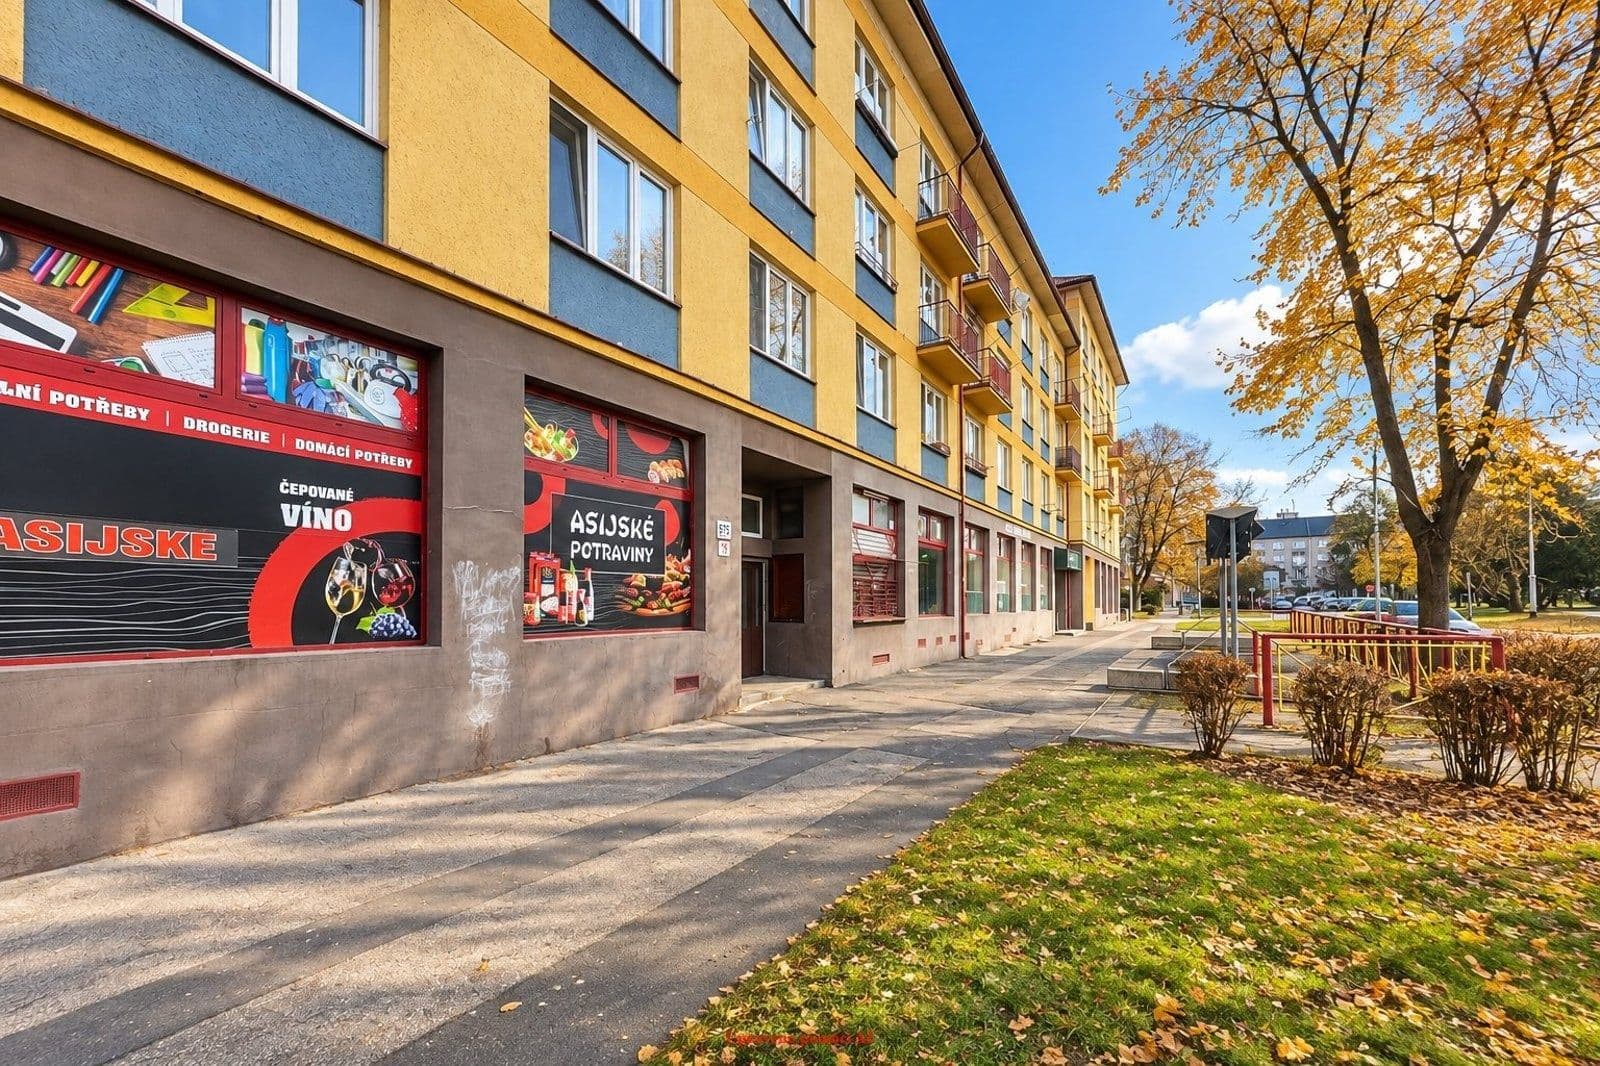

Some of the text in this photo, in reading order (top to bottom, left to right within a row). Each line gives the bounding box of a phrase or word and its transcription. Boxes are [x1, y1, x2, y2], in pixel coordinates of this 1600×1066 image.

[0, 379, 413, 469] LNÍ POTŘEBY DROGERIE DOMÁCÍ POTŘEBY
[279, 479, 354, 502] ČEPOVANÉ
[280, 501, 352, 532] VÍNO
[570, 509, 654, 541] ASIJSKÉ
[570, 540, 654, 563] POTRAVINY
